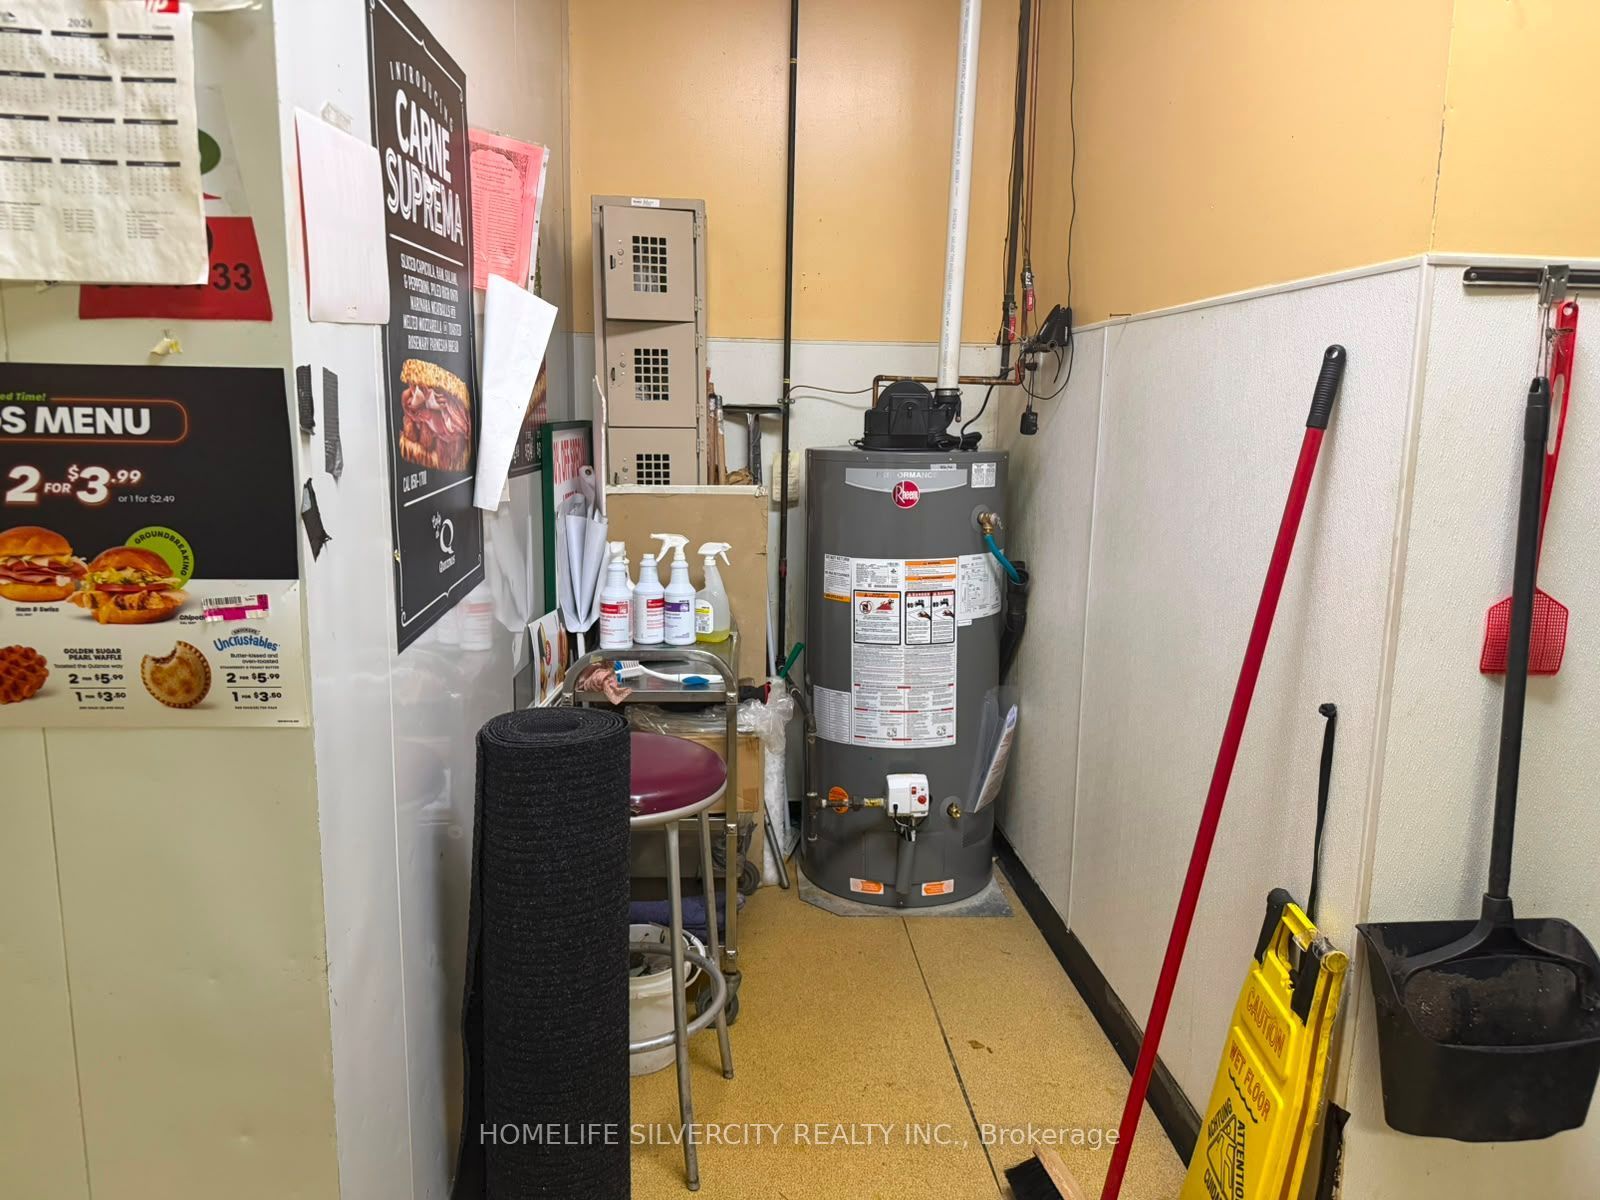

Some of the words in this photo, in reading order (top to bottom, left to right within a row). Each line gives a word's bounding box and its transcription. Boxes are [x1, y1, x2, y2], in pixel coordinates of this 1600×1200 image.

[389, 61, 454, 133] INTRODUCING
[395, 88, 452, 184] CARNE
[385, 147, 464, 247] SUPREMA
[212, 263, 252, 291] 33
[16, 392, 46, 401] Time!
[0, 405, 27, 434] S
[34, 406, 150, 435] MENU
[5, 465, 41, 502] 2
[44, 482, 72, 494] FOR
[67, 464, 142, 504] $3.99
[118, 495, 128, 503] or
[135, 494, 148, 503] for
[150, 494, 175, 503] $2.49
[895, 480, 919, 504] Rheem
[440, 518, 455, 554] Q
[134, 530, 190, 576] GROUNDBREAKING
[213, 634, 278, 652] Uncrustables
[68, 673, 79, 684] 2
[94, 673, 124, 684] $5.99
[226, 673, 237, 683] 2
[251, 673, 280, 683] $5.99
[75, 691, 83, 702] 1
[97, 691, 127, 702] $3.50
[231, 691, 239, 702] 1
[253, 691, 282, 702] $3.50
[1247, 987, 1285, 1058] CAUTION
[1230, 1040, 1246, 1075] WET
[1243, 1067, 1271, 1122] FLOOR
[1236, 1119, 1246, 1200] ATTENTIO
